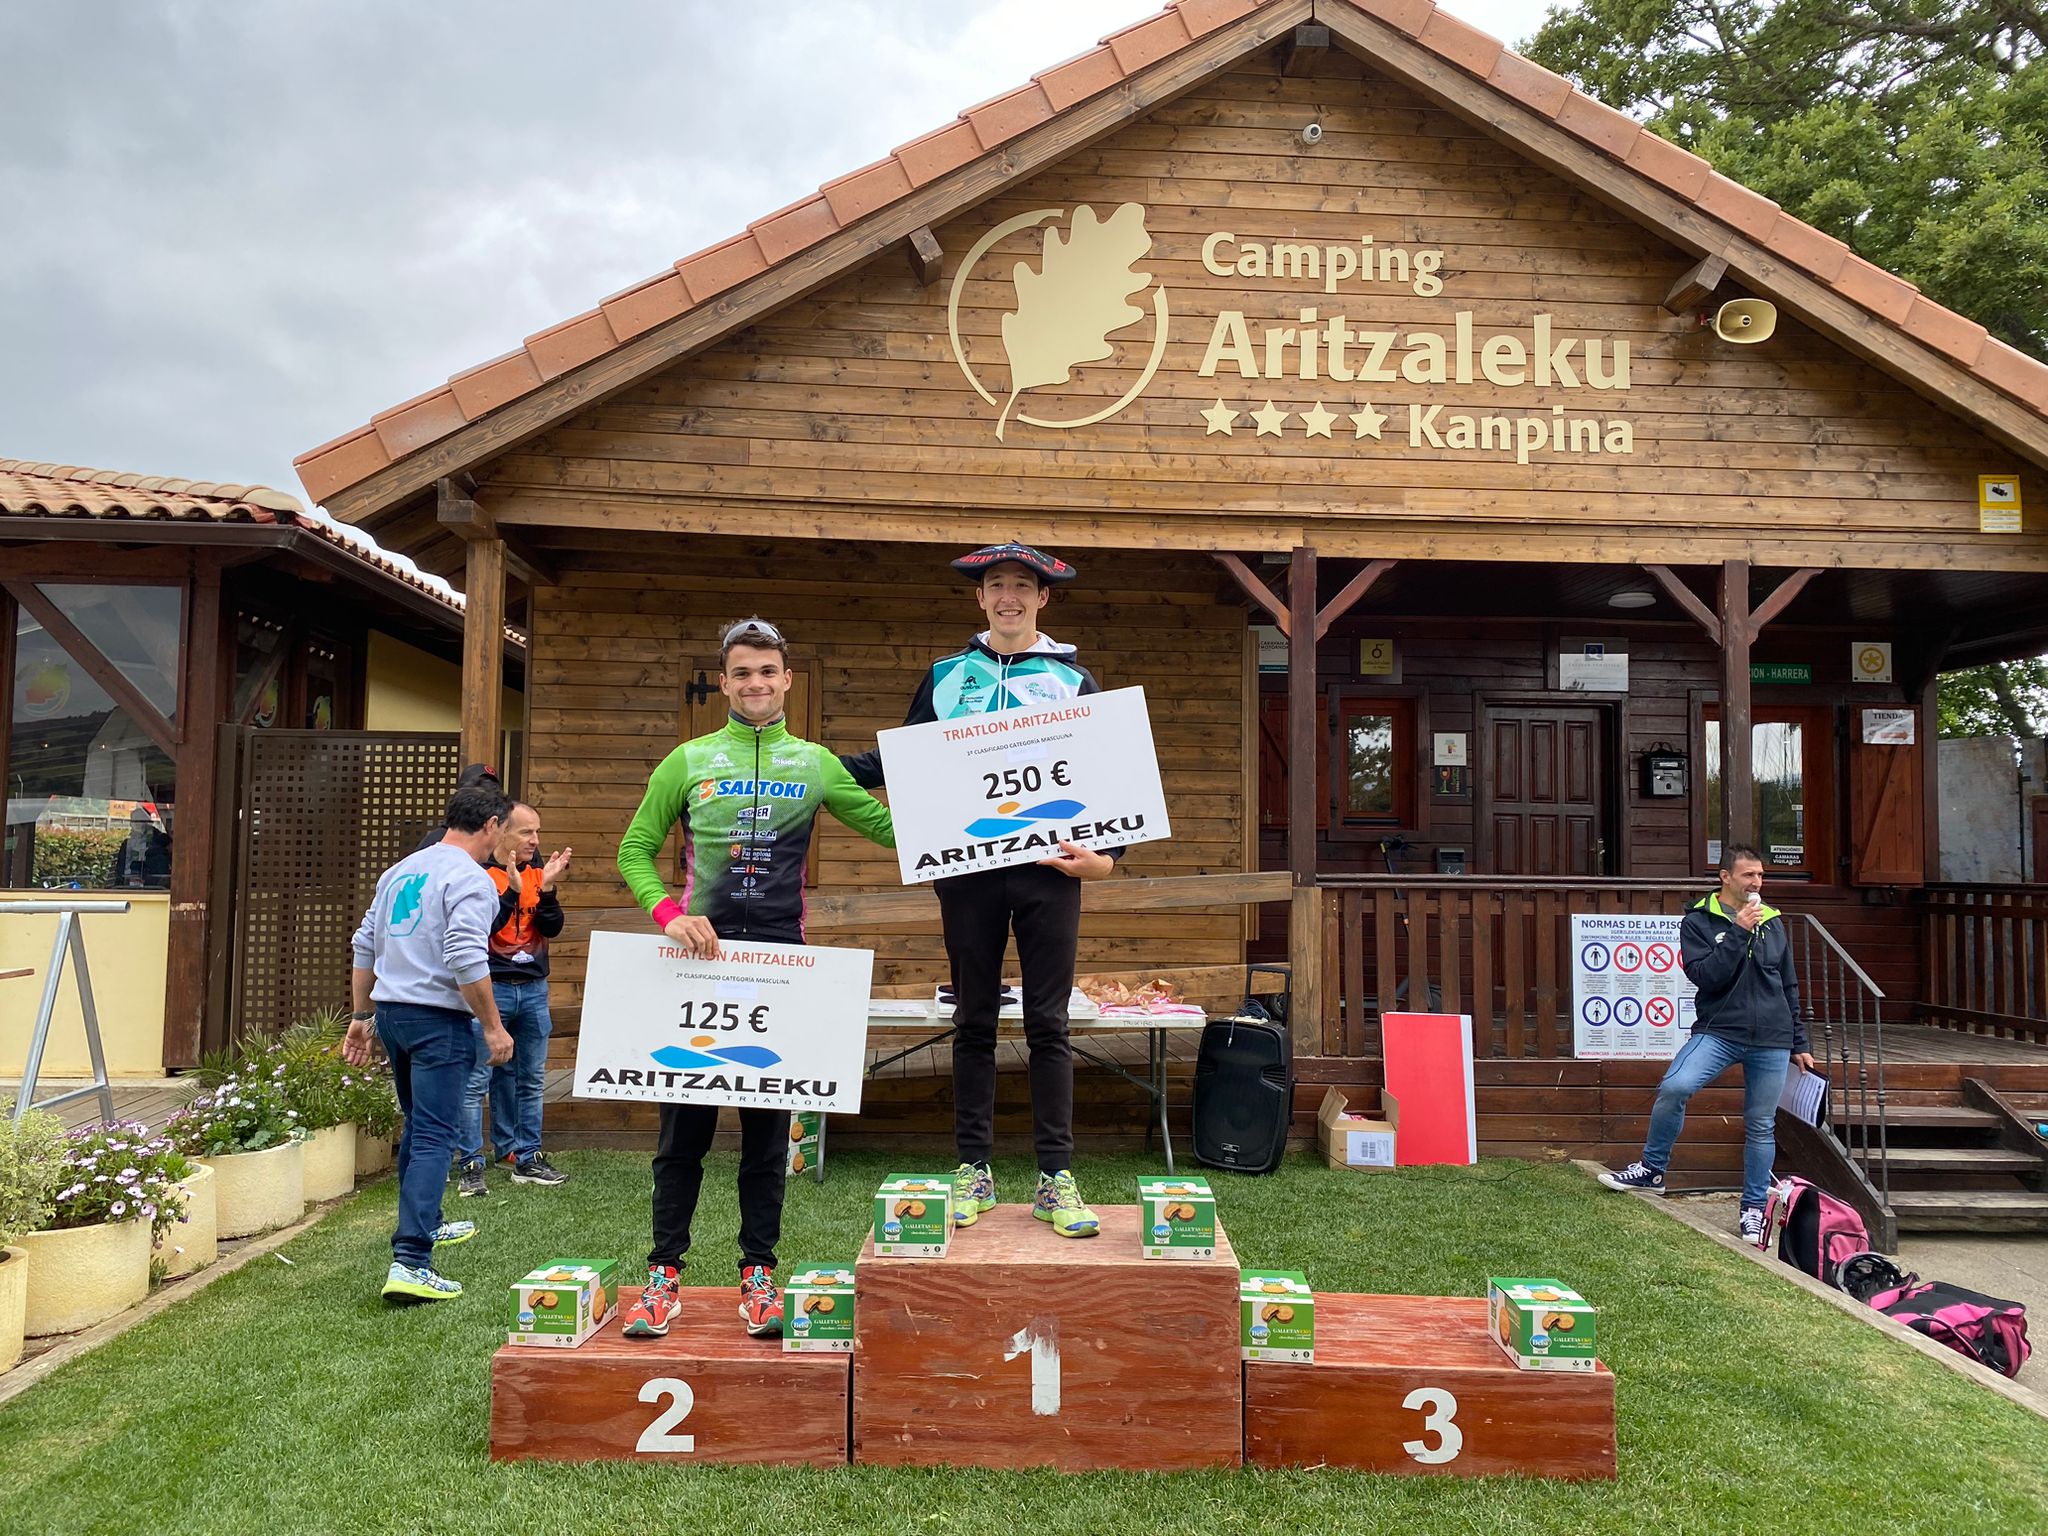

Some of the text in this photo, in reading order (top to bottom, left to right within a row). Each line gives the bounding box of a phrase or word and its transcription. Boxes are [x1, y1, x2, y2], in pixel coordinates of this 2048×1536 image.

[1201, 231, 1445, 298] Camping
[1198, 307, 1632, 390] Aritzaleku
[1408, 403, 1635, 465] Kanpina
[1772, 668, 1809, 679] HARRERA
[943, 705, 1091, 742] TRIATLON ARITZALEKU
[974, 744, 1009, 755] CLASIFICADO
[1009, 738, 1041, 749] CATEGORÍA
[1041, 732, 1073, 743] MASCULINA
[717, 780, 807, 799] SALTOKI
[982, 760, 1072, 800] 250 €
[915, 814, 1145, 870] ARITZALEKU
[915, 857, 1012, 880] TRIATLON
[1044, 832, 1148, 856] TRATLOIA
[1581, 920, 1625, 929] NORMAS
[1628, 920, 1641, 929] DE
[1644, 920, 1656, 929] LA
[731, 951, 815, 968] ARITZALEKU
[684, 972, 721, 981] CLASIFICADO
[721, 974, 755, 983] CATEGORÍA
[756, 977, 790, 985] MASCULINA
[679, 1000, 770, 1033] 125 €
[586, 1087, 691, 1099] TRIATLON
[726, 1095, 837, 1107] TRIATLOIA
[587, 1067, 838, 1097] ARITZALEKU
[1004, 1322, 1060, 1416] 1
[635, 1377, 695, 1453] 2
[1401, 1387, 1463, 1465] 3
